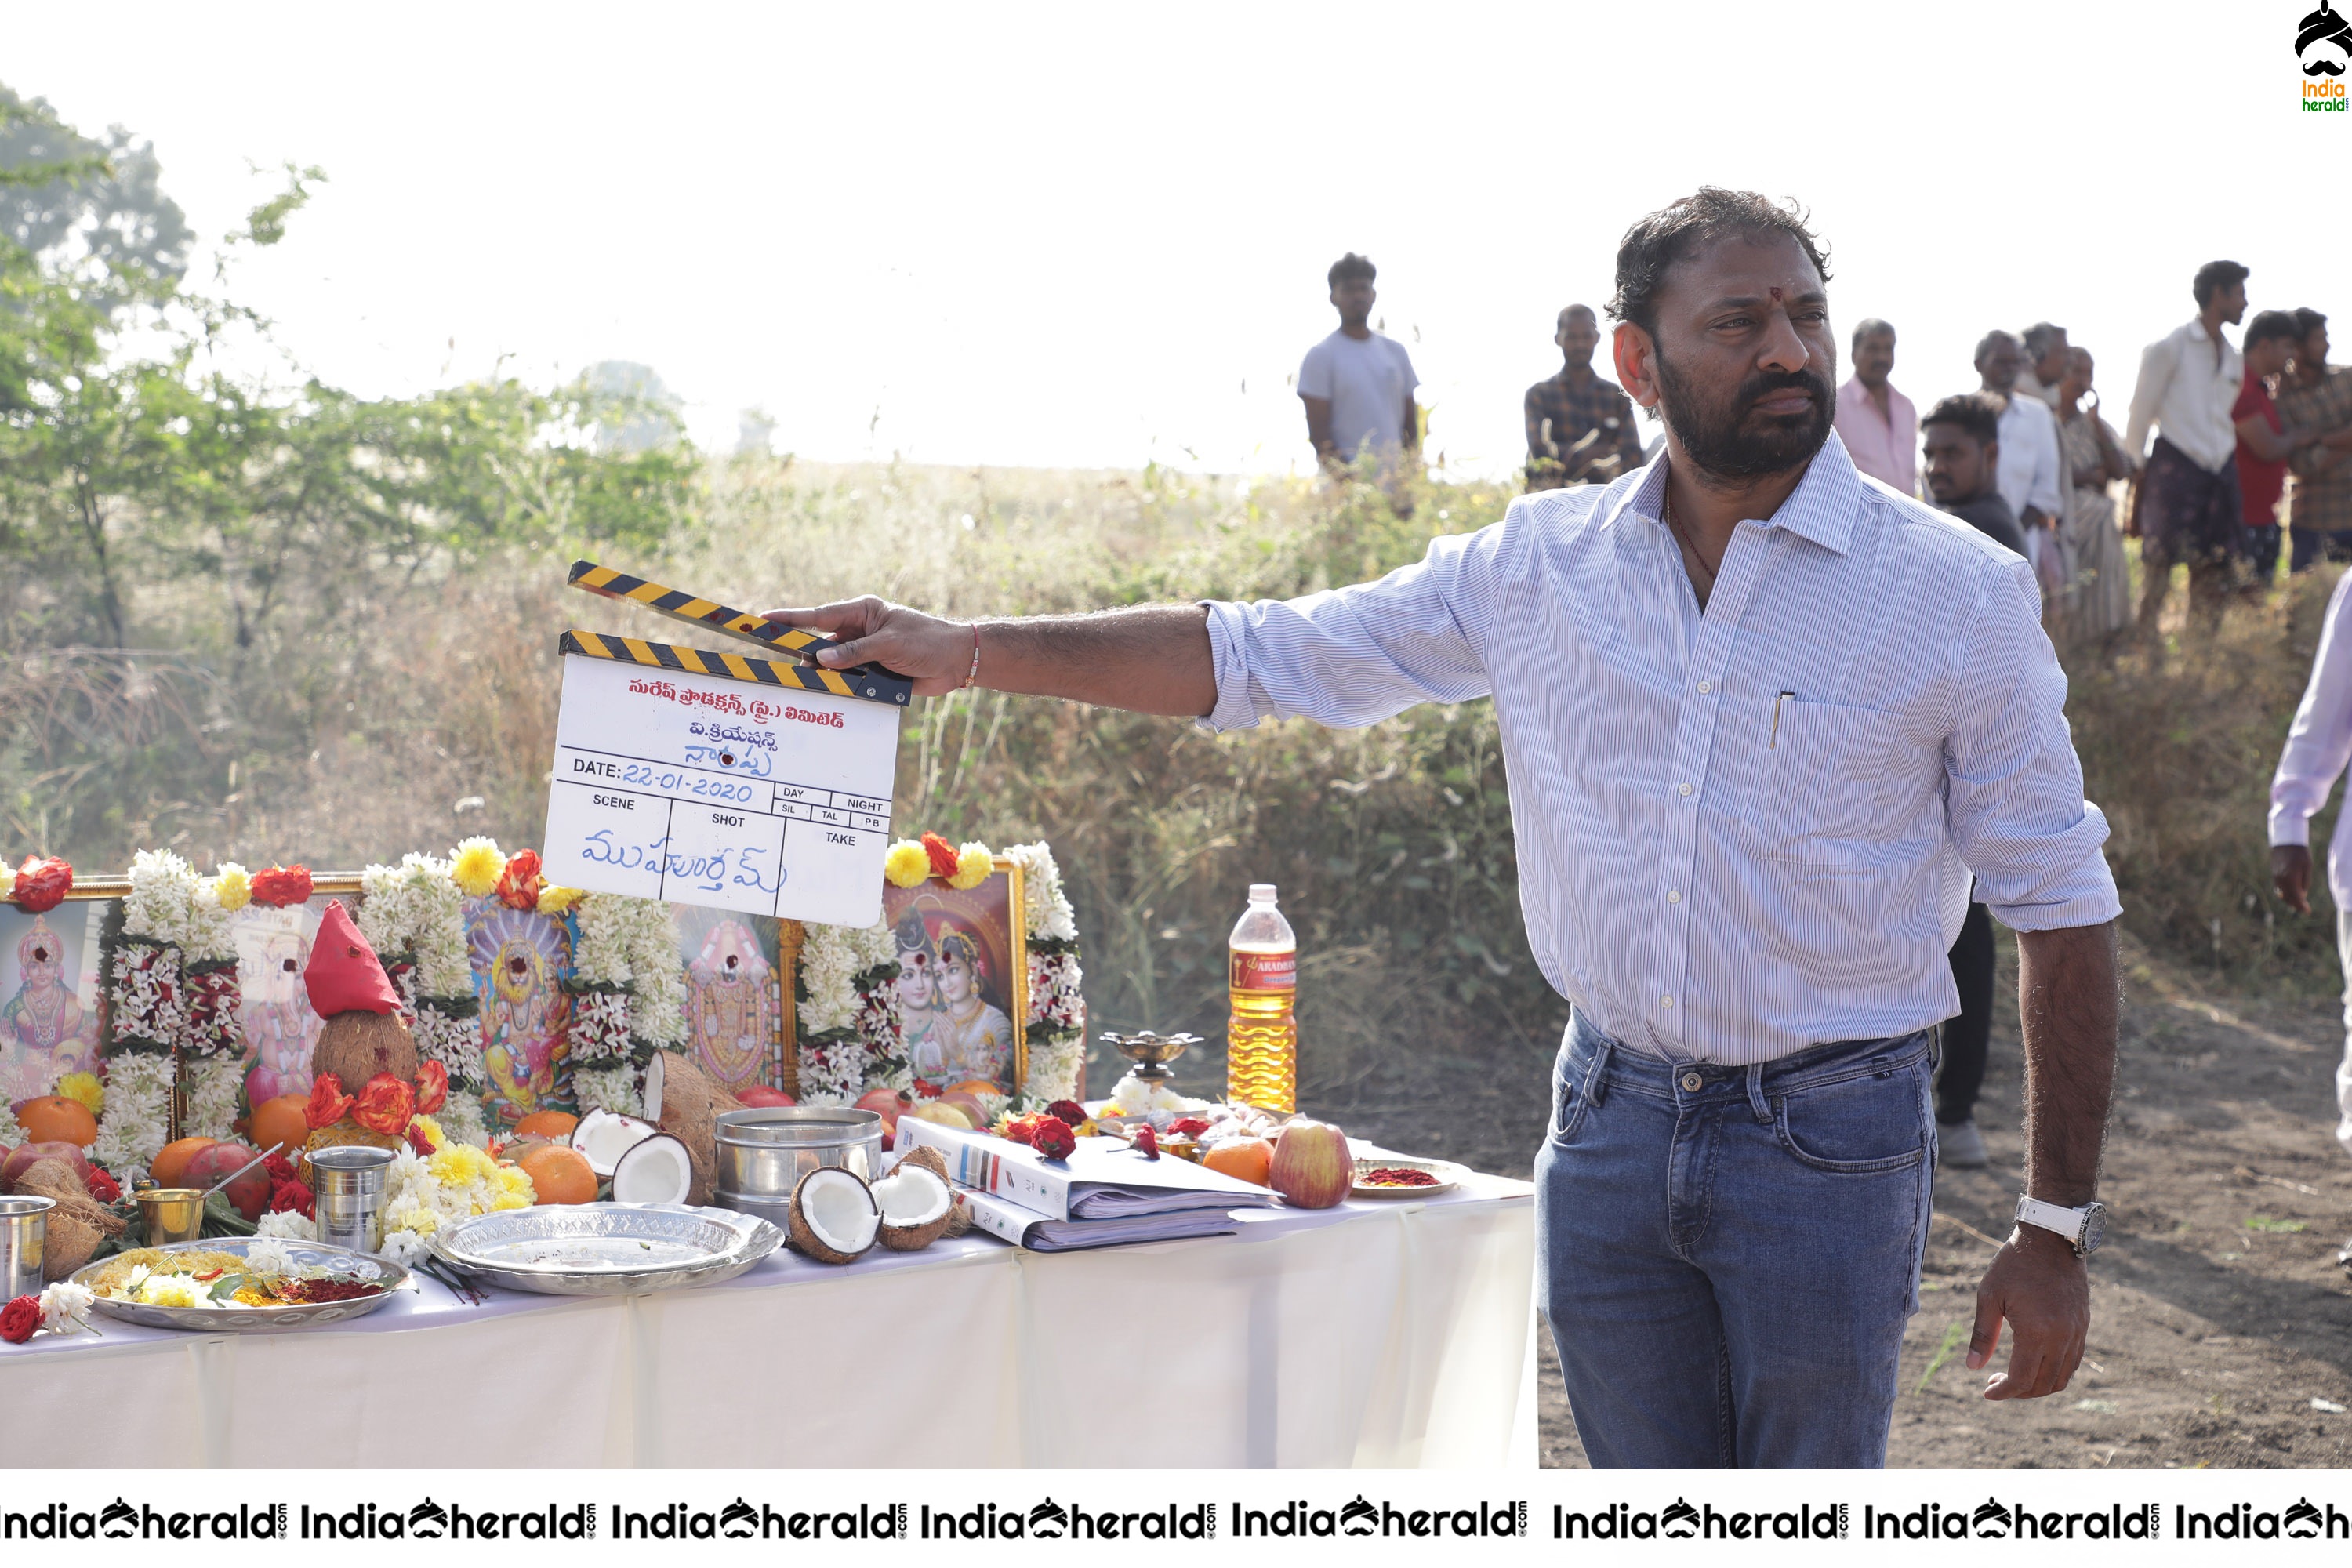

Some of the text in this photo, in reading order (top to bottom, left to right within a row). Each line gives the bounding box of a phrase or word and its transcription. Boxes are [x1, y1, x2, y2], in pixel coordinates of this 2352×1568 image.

[629, 679, 676, 701] సురేష్
[784, 706, 844, 728] లిమిటెడ్
[573, 758, 622, 779] DATE:
[623, 764, 753, 802] 22-01-2020
[783, 787, 804, 799] DAY
[593, 794, 635, 811] SCENE
[782, 804, 796, 814] SIL
[848, 798, 884, 812] NIGHT
[712, 813, 746, 828] SHOT
[822, 811, 838, 821] TAL
[826, 832, 856, 846] TAKE
